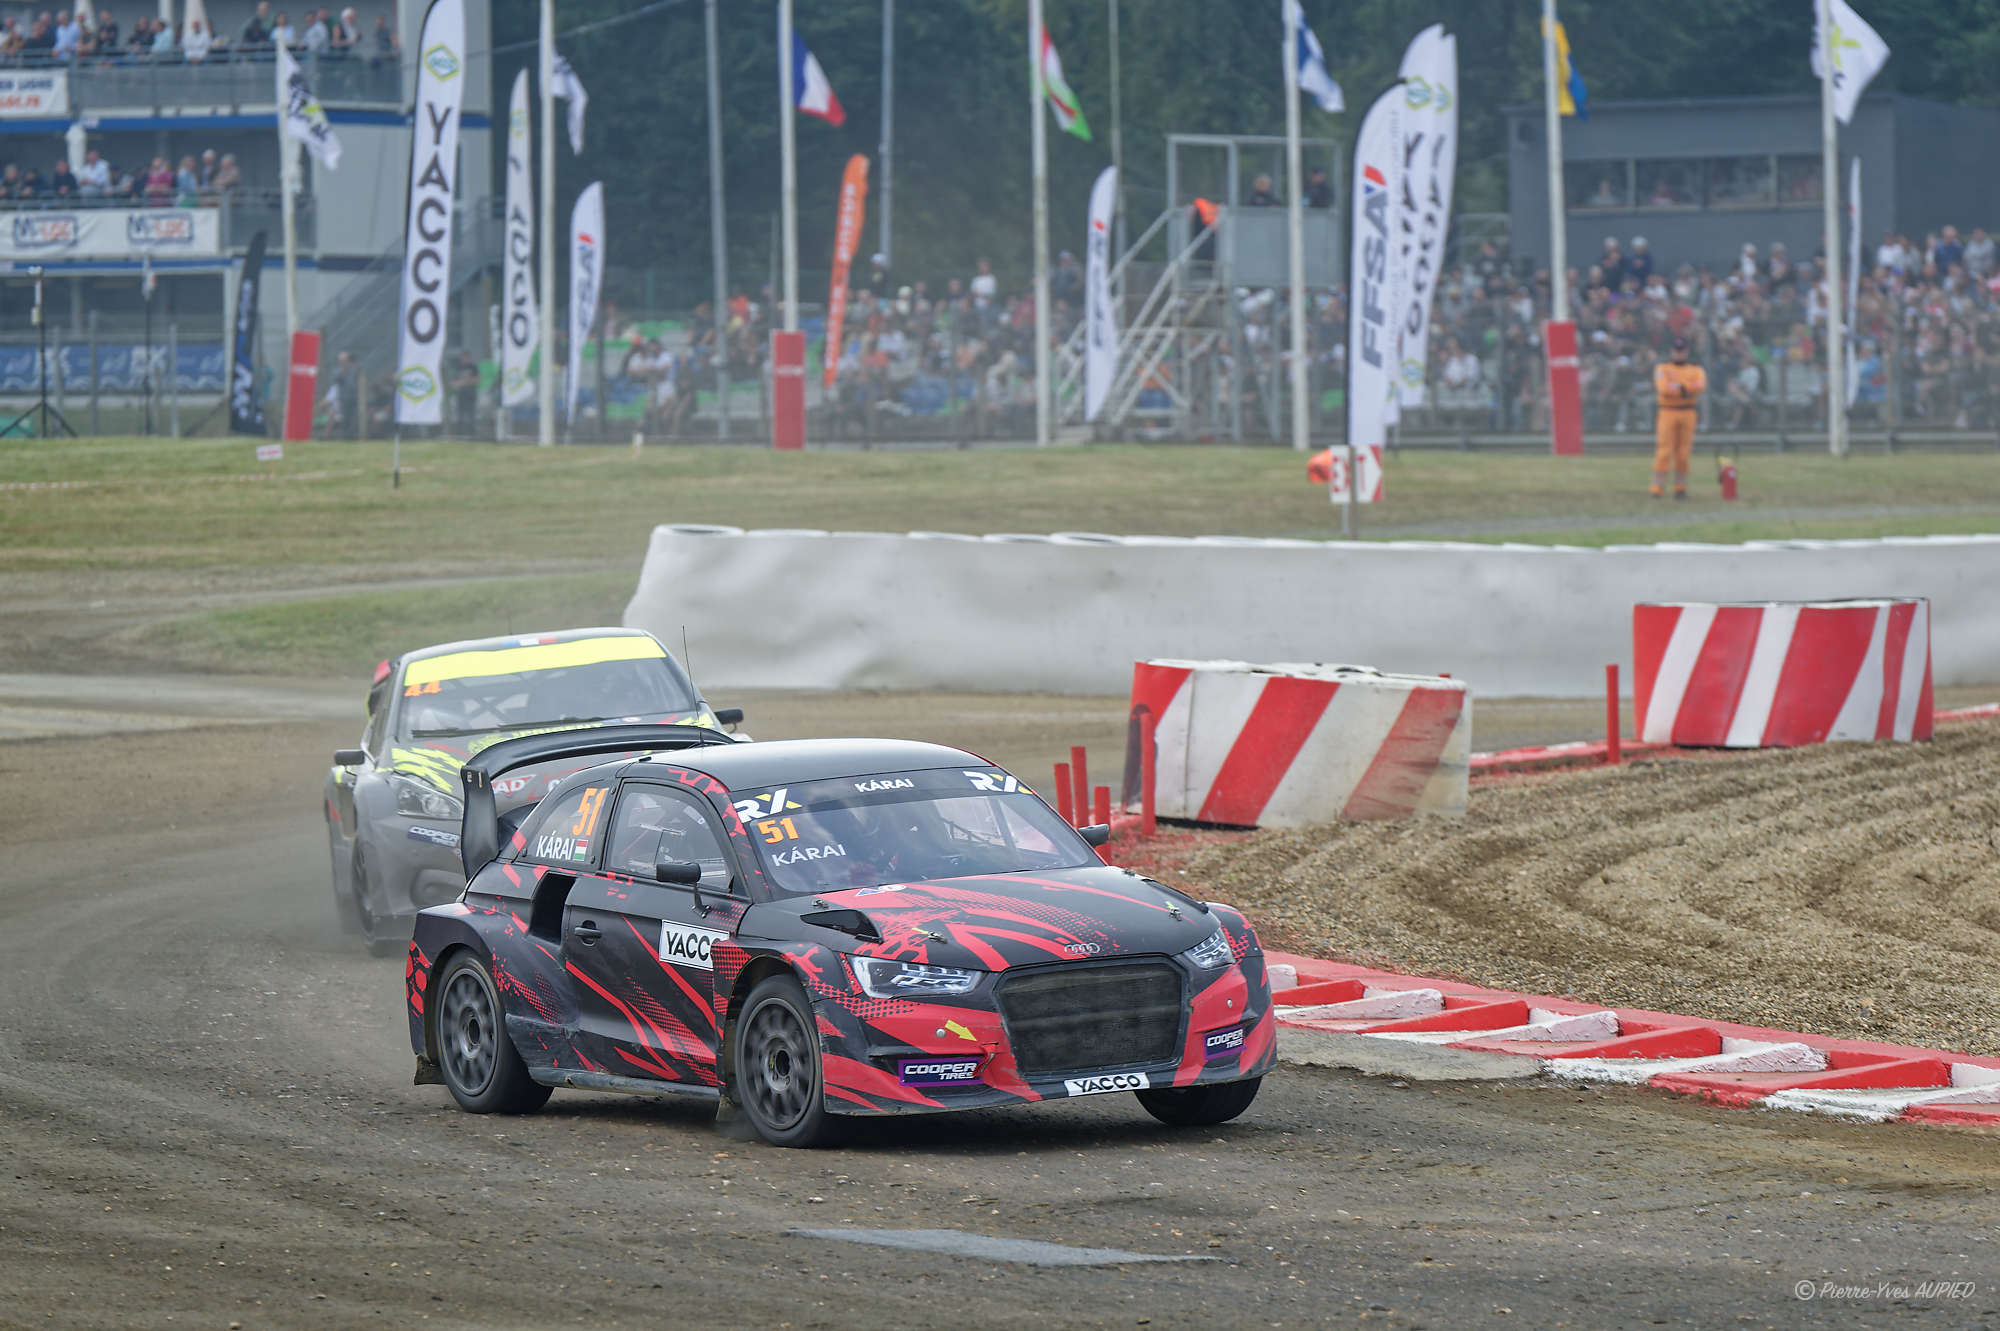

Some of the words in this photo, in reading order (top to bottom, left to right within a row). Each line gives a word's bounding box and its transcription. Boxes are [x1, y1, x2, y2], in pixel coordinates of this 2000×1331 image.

[407, 103, 453, 343] YACCO
[1361, 188, 1389, 370] FFSA
[855, 778, 914, 793] KÁRAI
[961, 770, 1033, 794] RX
[572, 787, 608, 837] 51
[734, 788, 802, 823] RX
[757, 817, 799, 844] 51
[536, 830, 575, 860] KÁRAI
[771, 844, 846, 867] KÁRAI
[666, 931, 720, 961] YACC
[1207, 1029, 1243, 1046] COOPER
[905, 1063, 977, 1074] COOPER
[938, 1071, 975, 1081] TIRES
[1074, 1075, 1141, 1092] YACCO
